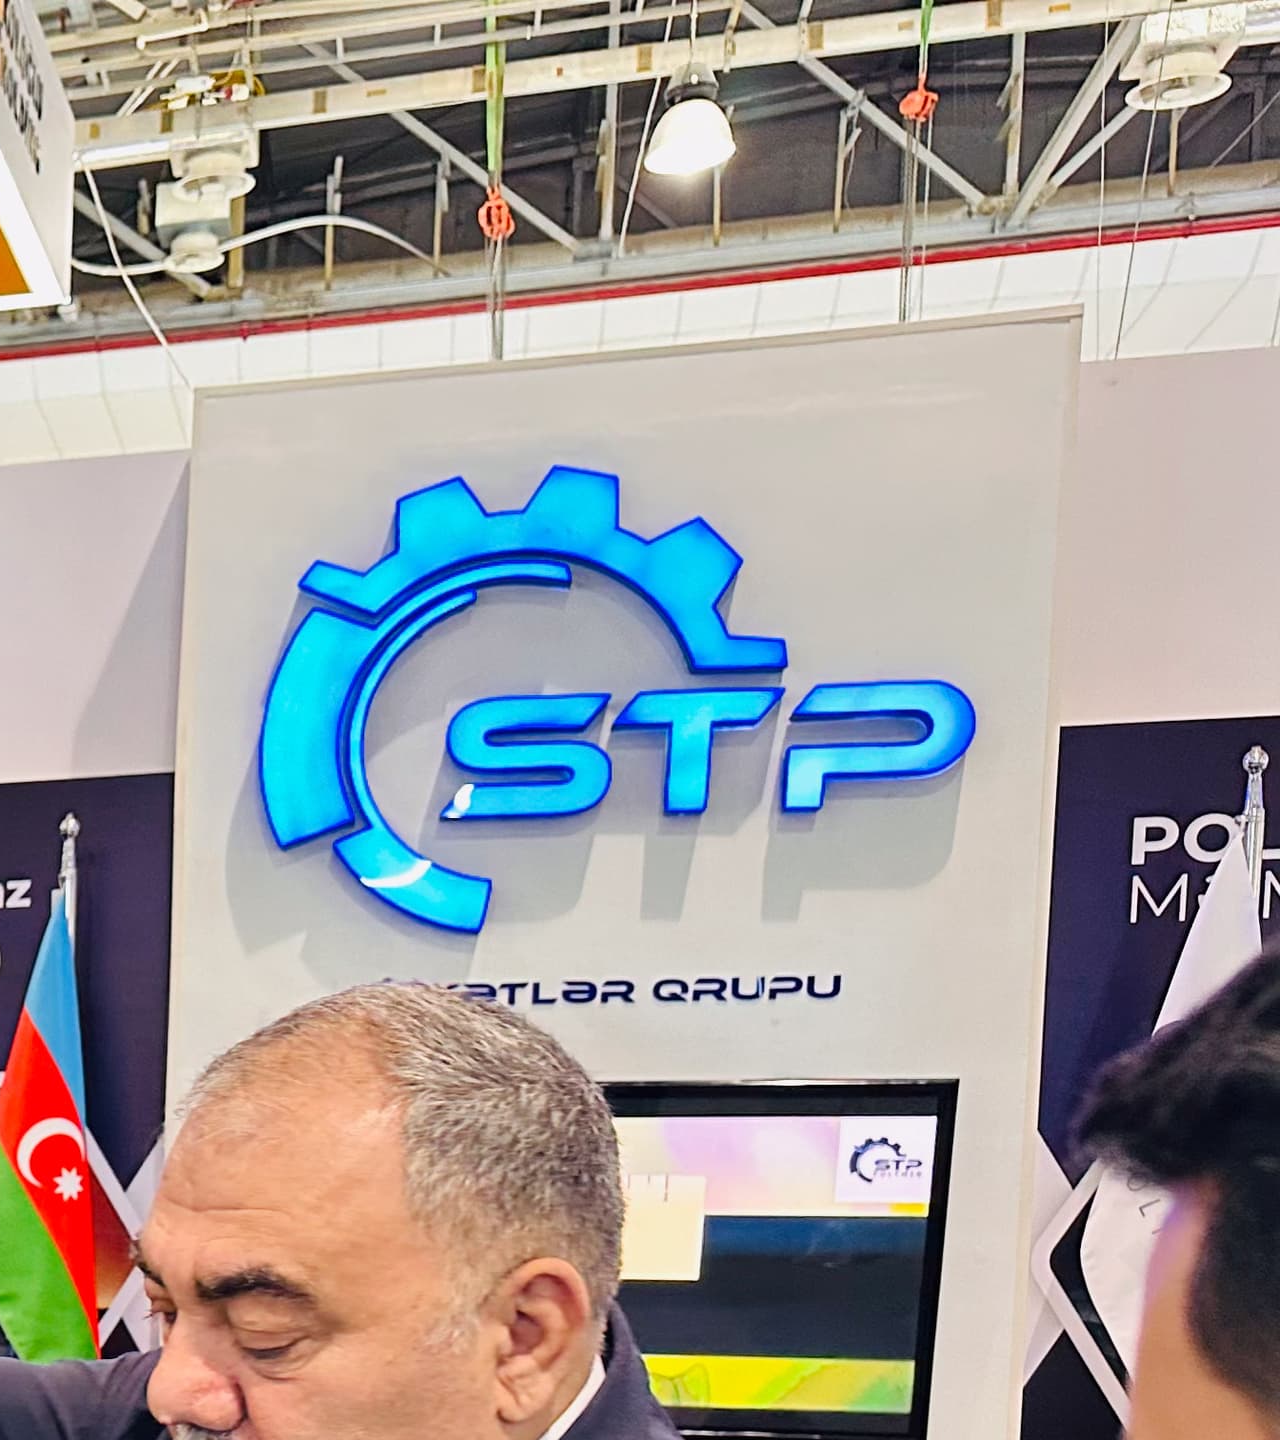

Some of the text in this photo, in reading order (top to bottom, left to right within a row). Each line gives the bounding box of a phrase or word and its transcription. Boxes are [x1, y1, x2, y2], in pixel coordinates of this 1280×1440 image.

[441, 679, 977, 821] STP
[1131, 812, 1280, 865] PO
[652, 974, 842, 1002] QRUPU
